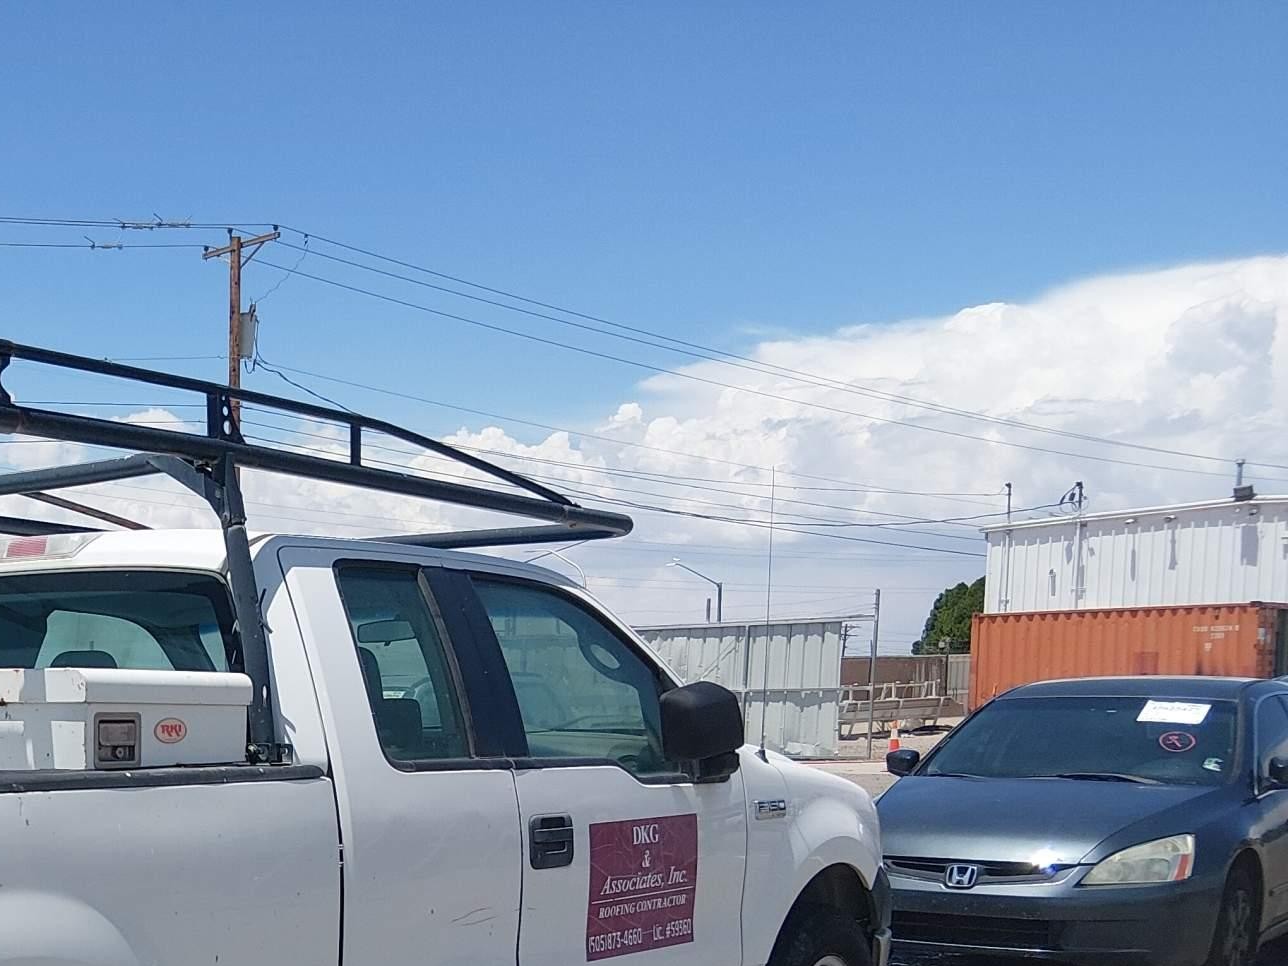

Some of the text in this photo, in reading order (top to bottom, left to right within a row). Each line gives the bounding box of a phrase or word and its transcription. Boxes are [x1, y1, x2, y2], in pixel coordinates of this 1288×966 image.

[160, 724, 182, 737] RKI
[632, 824, 659, 845] DKG
[641, 849, 651, 868] &
[600, 865, 688, 895] Associates, Inc.
[598, 894, 687, 919] ROOFING CONTRACTOR
